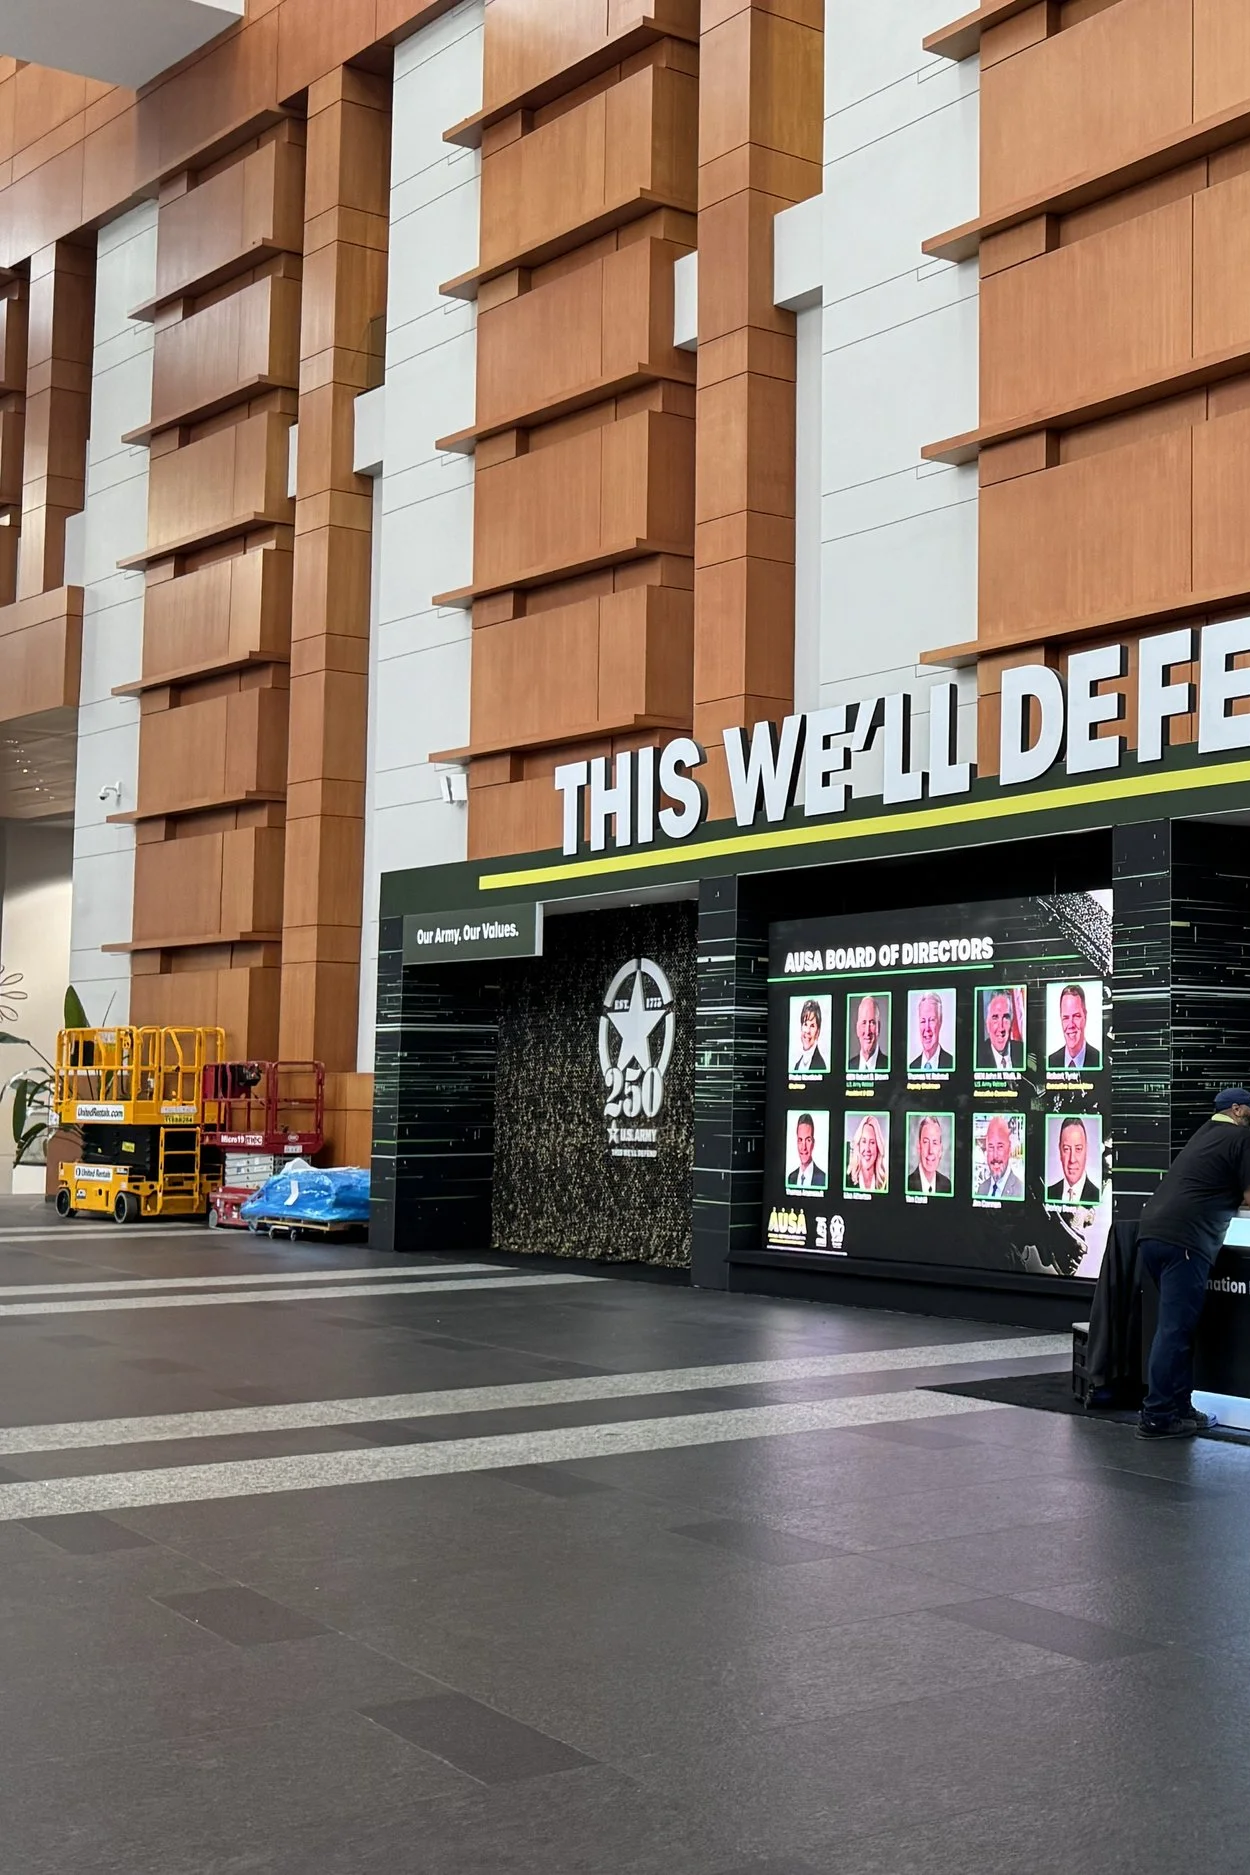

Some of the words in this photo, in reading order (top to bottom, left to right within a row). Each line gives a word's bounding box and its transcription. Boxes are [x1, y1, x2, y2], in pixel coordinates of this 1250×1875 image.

[555, 737, 704, 856] THIS
[723, 682, 973, 827] WE'LL
[416, 929, 433, 945] Our
[434, 927, 461, 945] Army.
[463, 924, 481, 941] Our
[482, 921, 519, 939] Values.
[784, 950, 824, 973] AUSA
[825, 946, 877, 970] BOARD
[878, 943, 900, 967] OF
[902, 936, 994, 965] DIRECTORS
[603, 1067, 665, 1118] 250
[768, 1211, 807, 1235] AUSA
